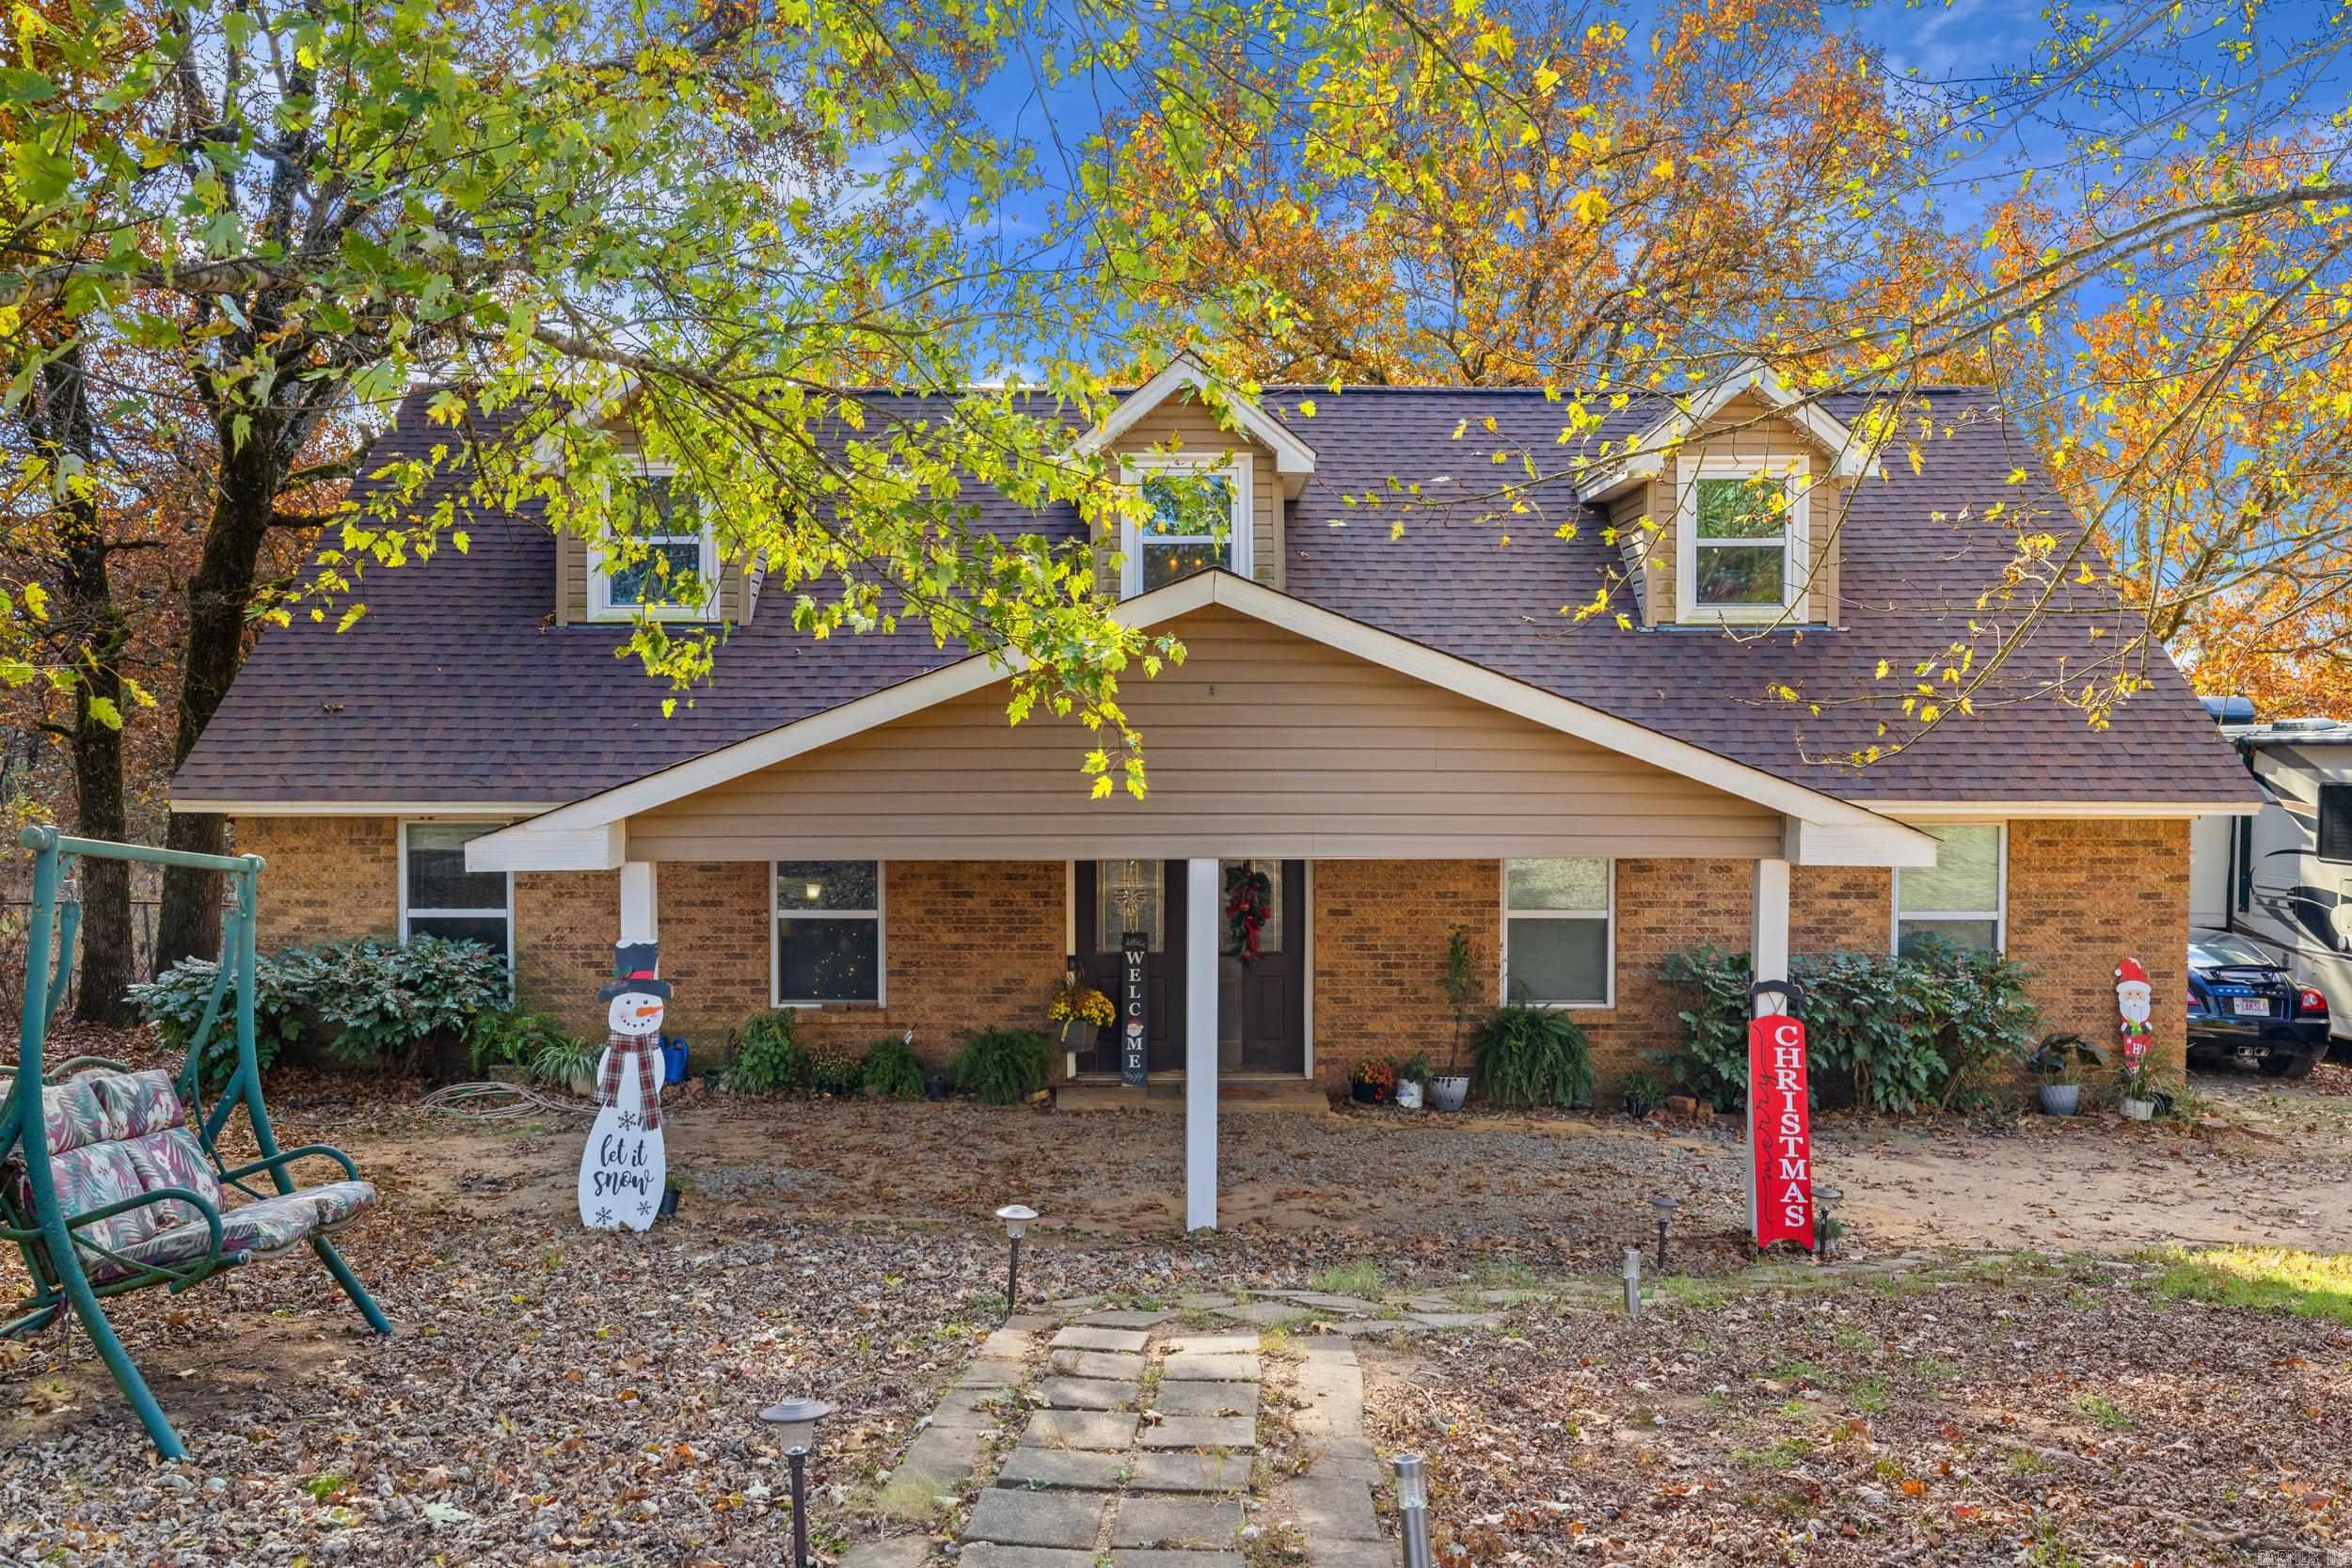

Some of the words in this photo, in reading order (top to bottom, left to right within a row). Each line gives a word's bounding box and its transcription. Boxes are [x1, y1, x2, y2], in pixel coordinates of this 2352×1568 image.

[593, 1168, 655, 1197] snow
[600, 1133, 628, 1167] let
[631, 1139, 648, 1167] it
[1753, 1024, 1777, 1225] merry
[1773, 1024, 1809, 1227] CHRISTMAS
